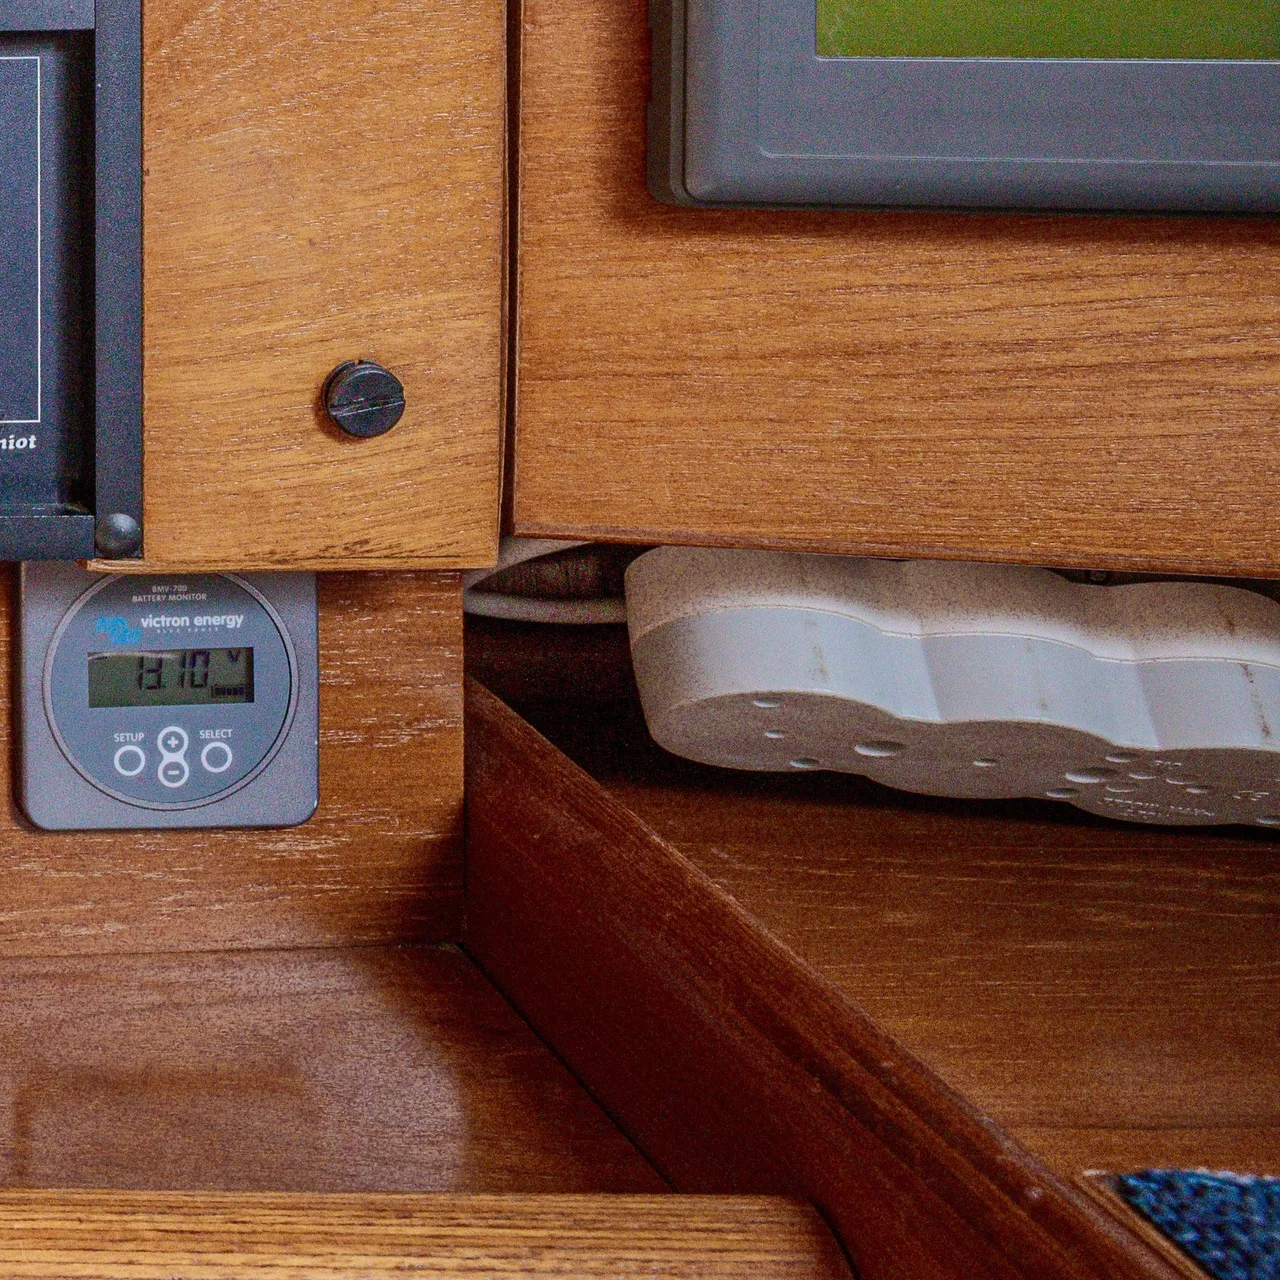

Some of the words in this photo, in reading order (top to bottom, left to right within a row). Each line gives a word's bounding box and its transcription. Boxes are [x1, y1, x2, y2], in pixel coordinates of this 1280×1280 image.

[141, 615, 189, 627] victron
[194, 614, 243, 628] energy
[229, 650, 240, 662] V
